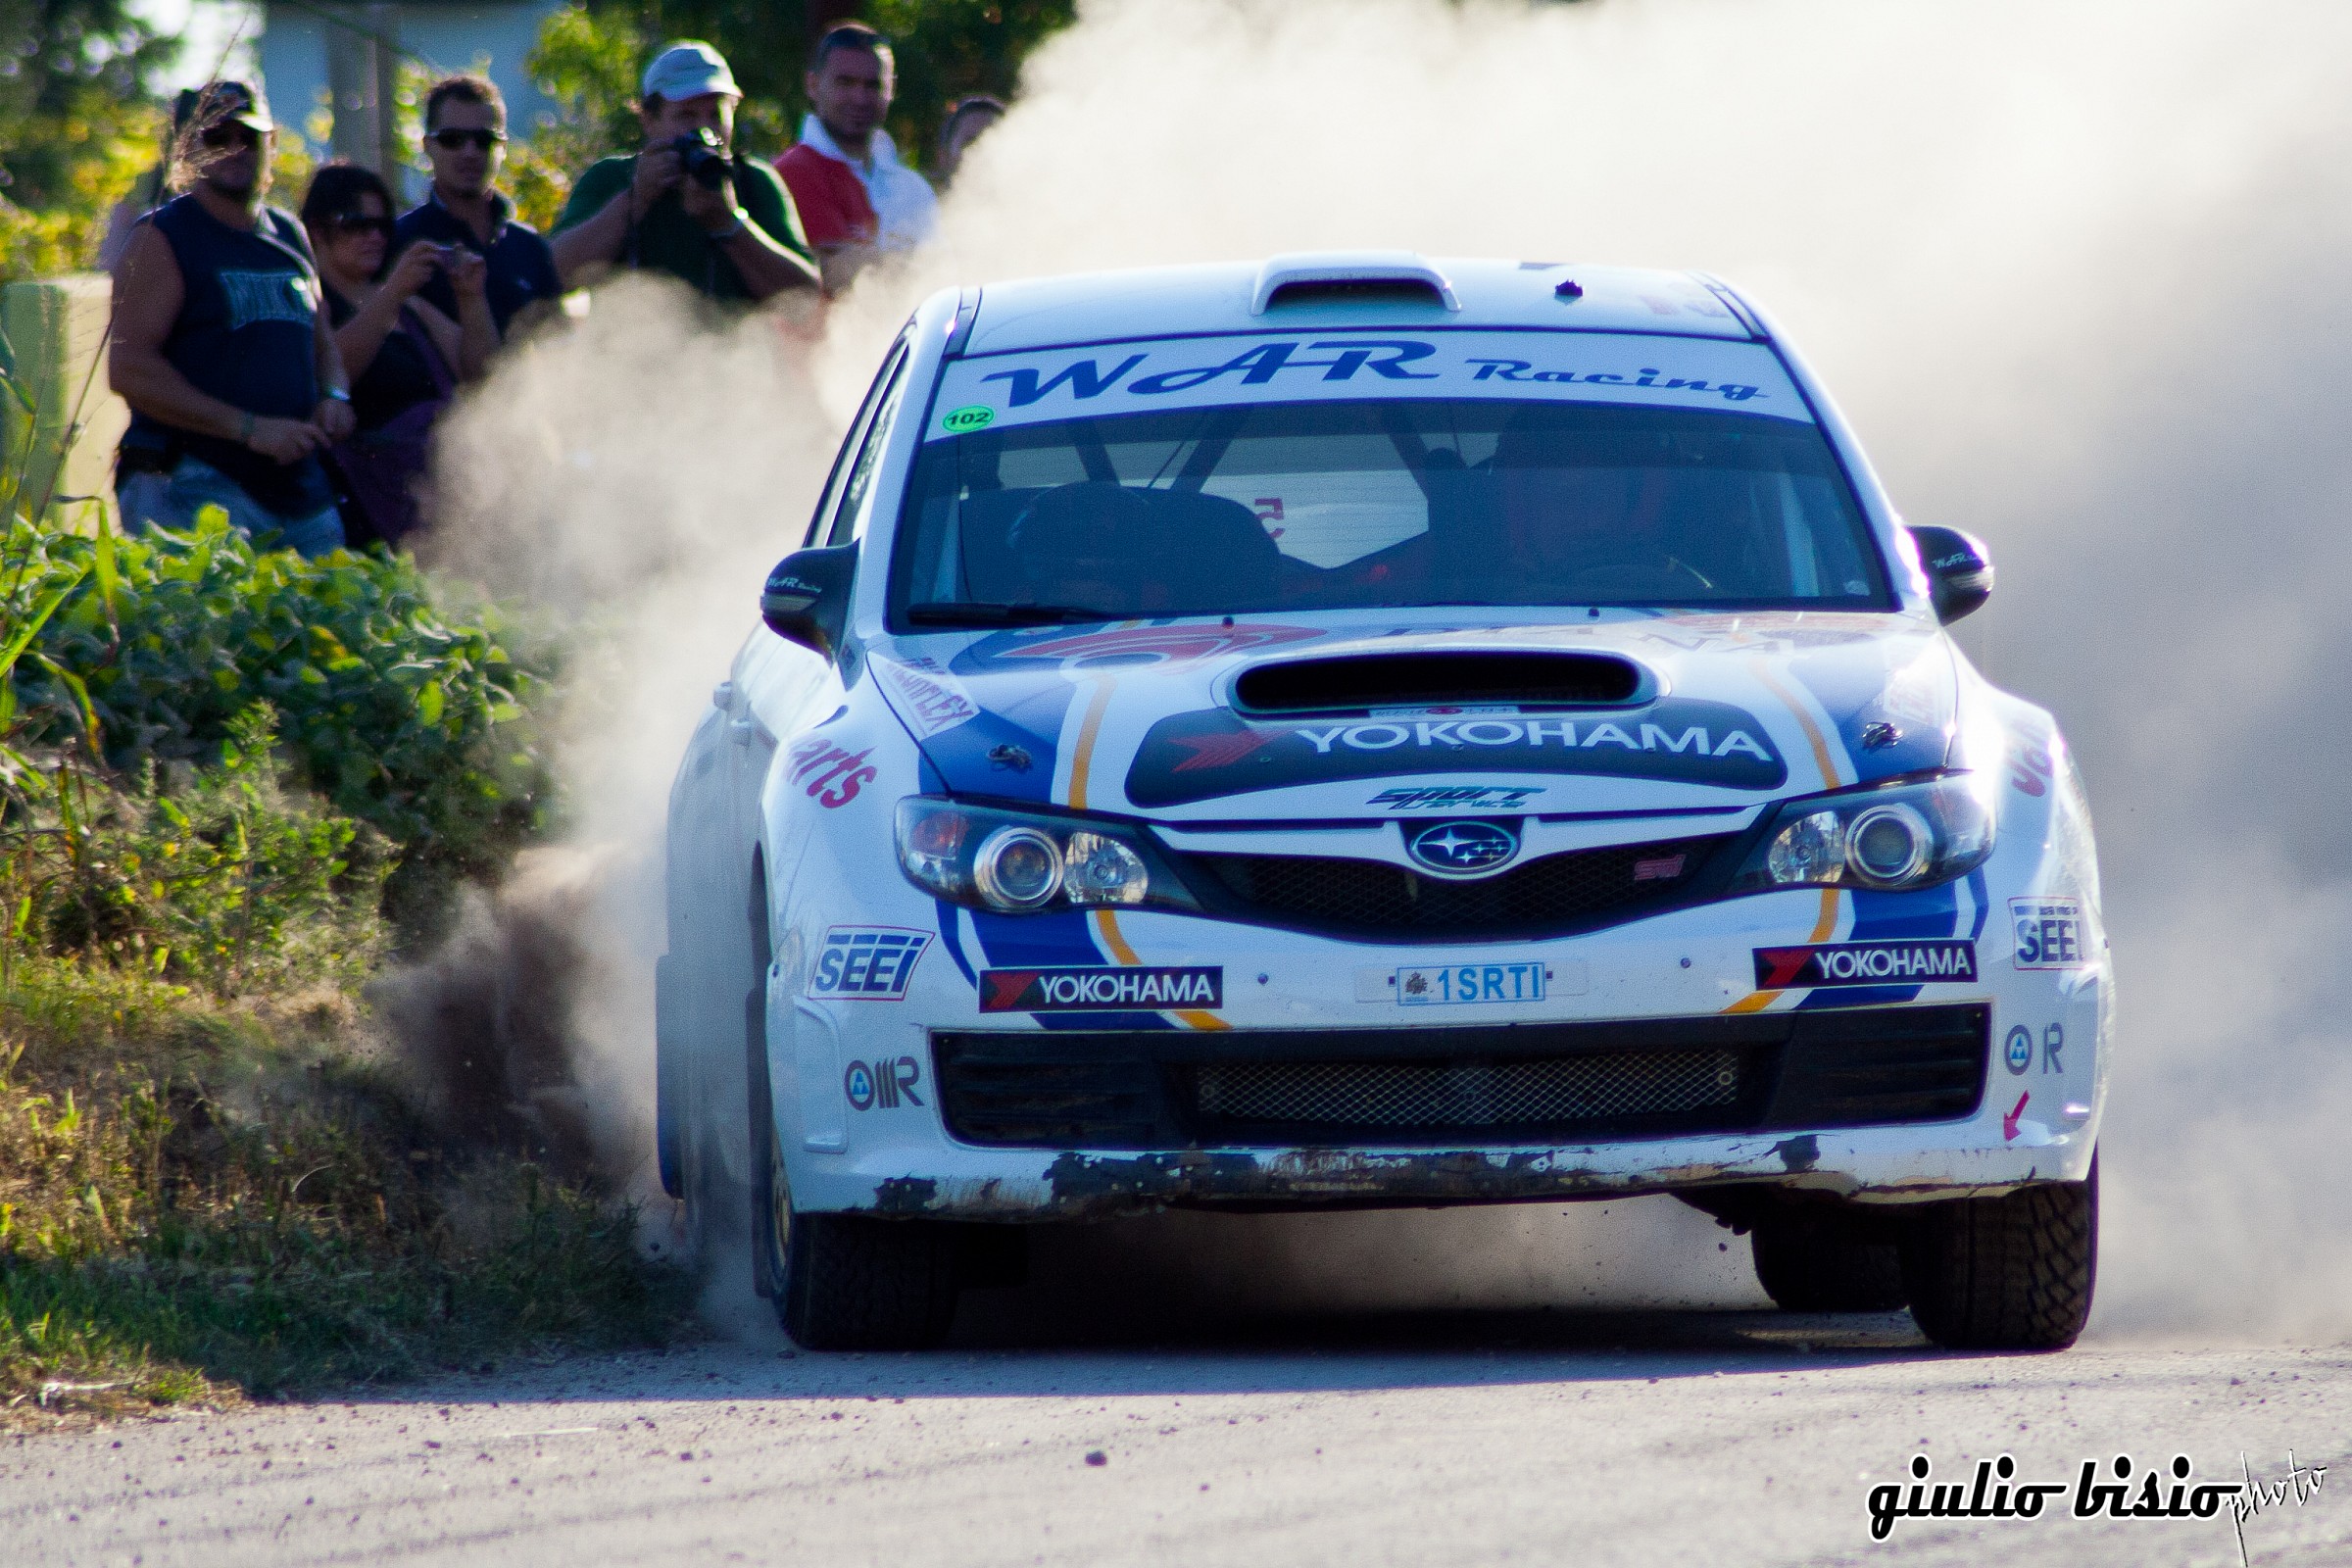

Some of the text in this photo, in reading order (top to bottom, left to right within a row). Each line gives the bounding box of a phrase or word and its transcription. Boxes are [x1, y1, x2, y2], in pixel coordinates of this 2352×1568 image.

[1465, 359, 1769, 401] Racing
[947, 412, 990, 426] 102
[1295, 720, 1774, 761] YOKOHAMA
[1815, 947, 1972, 979] YOKOHAMA
[1038, 974, 1214, 1004] YOKOHAMA
[1437, 965, 1540, 1001] 1SRTI
